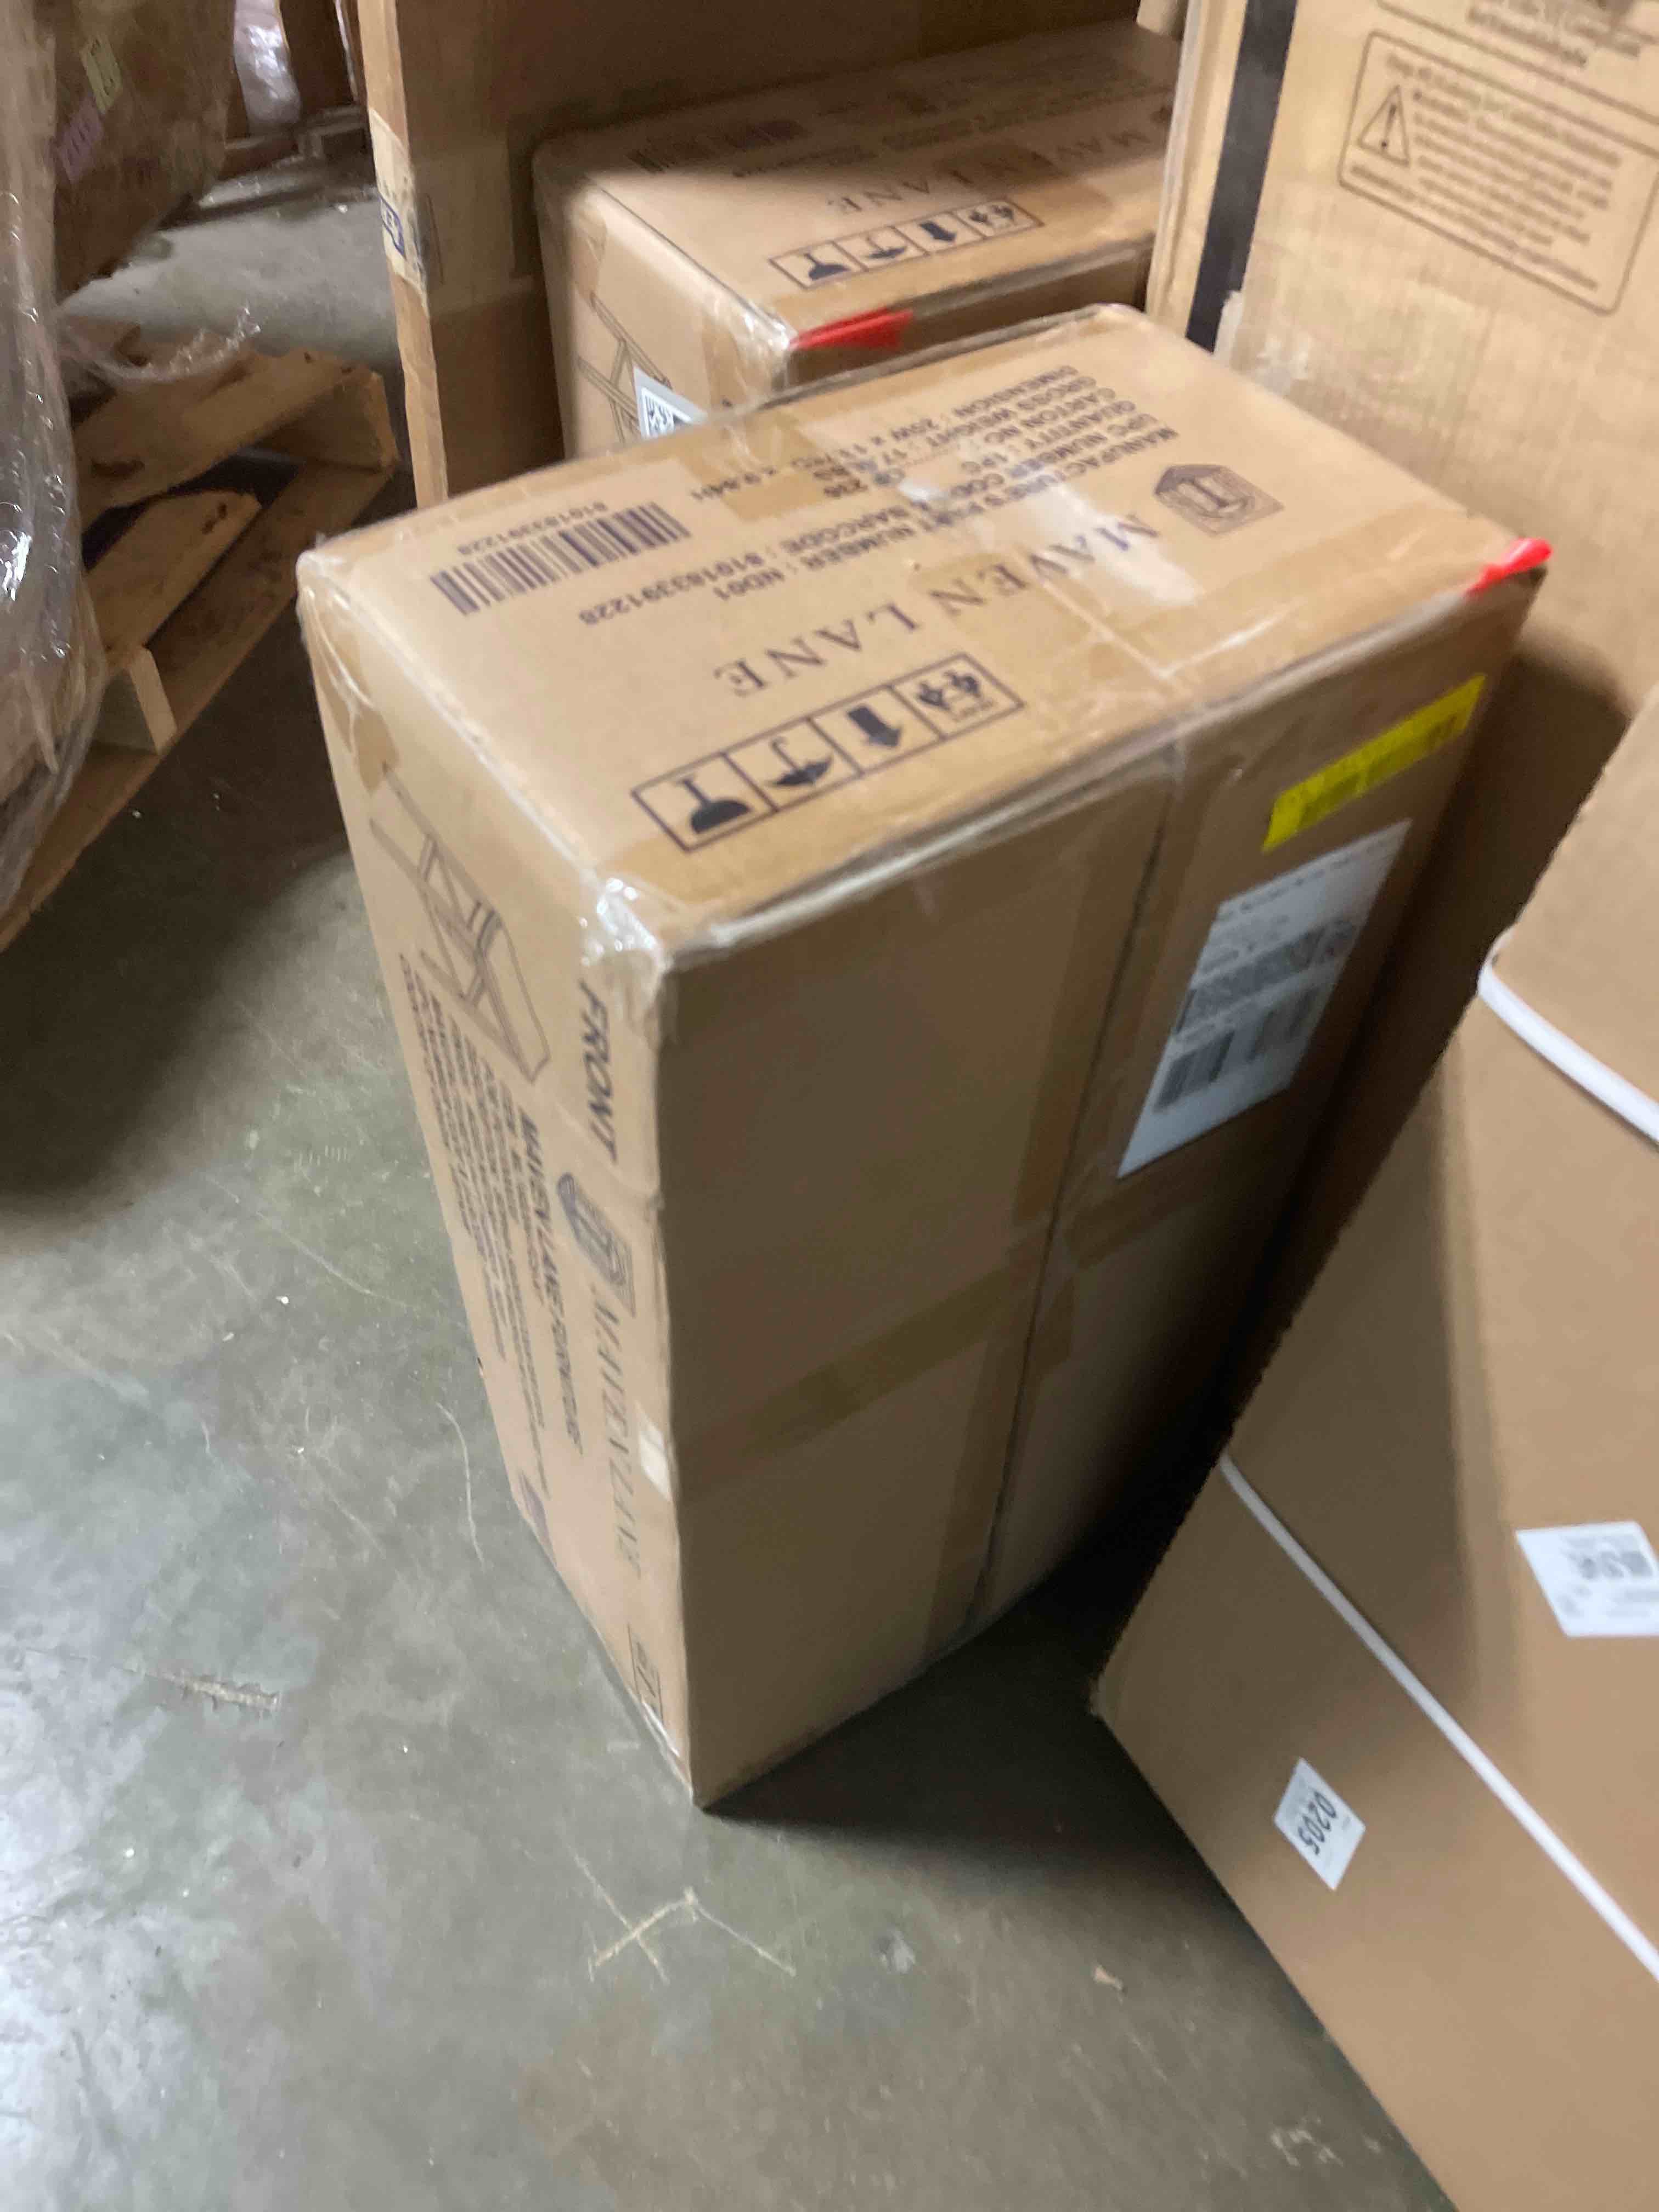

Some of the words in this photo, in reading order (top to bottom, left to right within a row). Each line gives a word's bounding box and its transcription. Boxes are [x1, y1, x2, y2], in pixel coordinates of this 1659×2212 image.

[922, 512, 1163, 616] MAVEN
[708, 602, 923, 700] LANE
[578, 979, 619, 1164] FRONT
